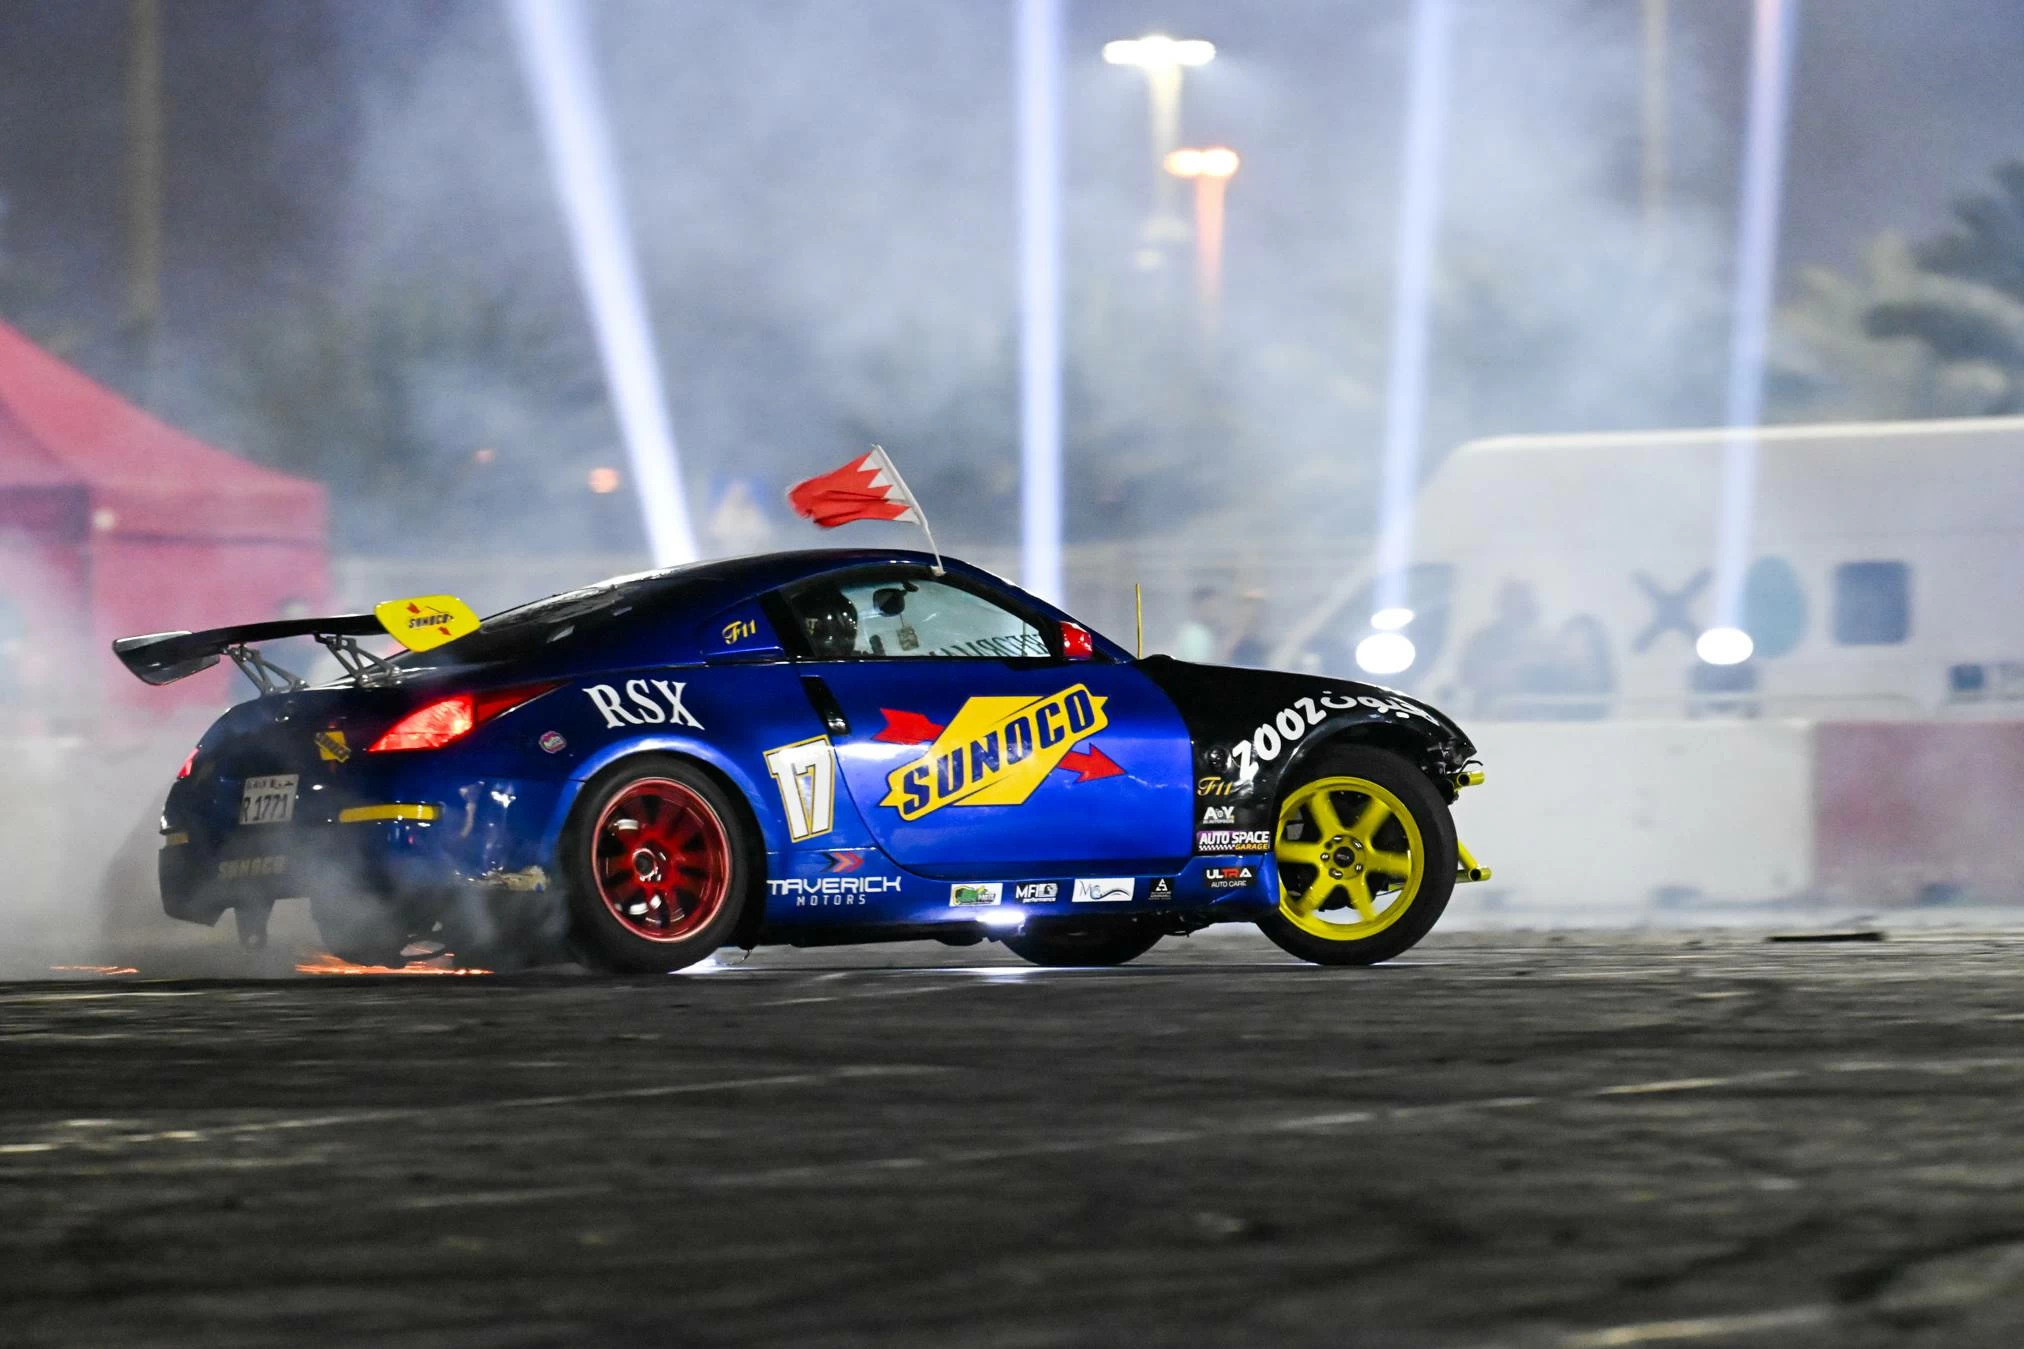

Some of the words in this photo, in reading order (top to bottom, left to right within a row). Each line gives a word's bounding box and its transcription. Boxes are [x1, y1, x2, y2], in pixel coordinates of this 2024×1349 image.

[408, 613, 449, 629] SUNOCO
[581, 678, 705, 731] RSX
[903, 689, 1095, 816] SUNOCO
[762, 734, 836, 843] 17
[1200, 831, 1230, 845] AUTO
[1231, 831, 1270, 844] SPACE
[1206, 867, 1253, 879] ULTRA
[1211, 880, 1229, 888] AUTO
[1228, 880, 1248, 888] CARE
[796, 893, 866, 907] MOTORS
